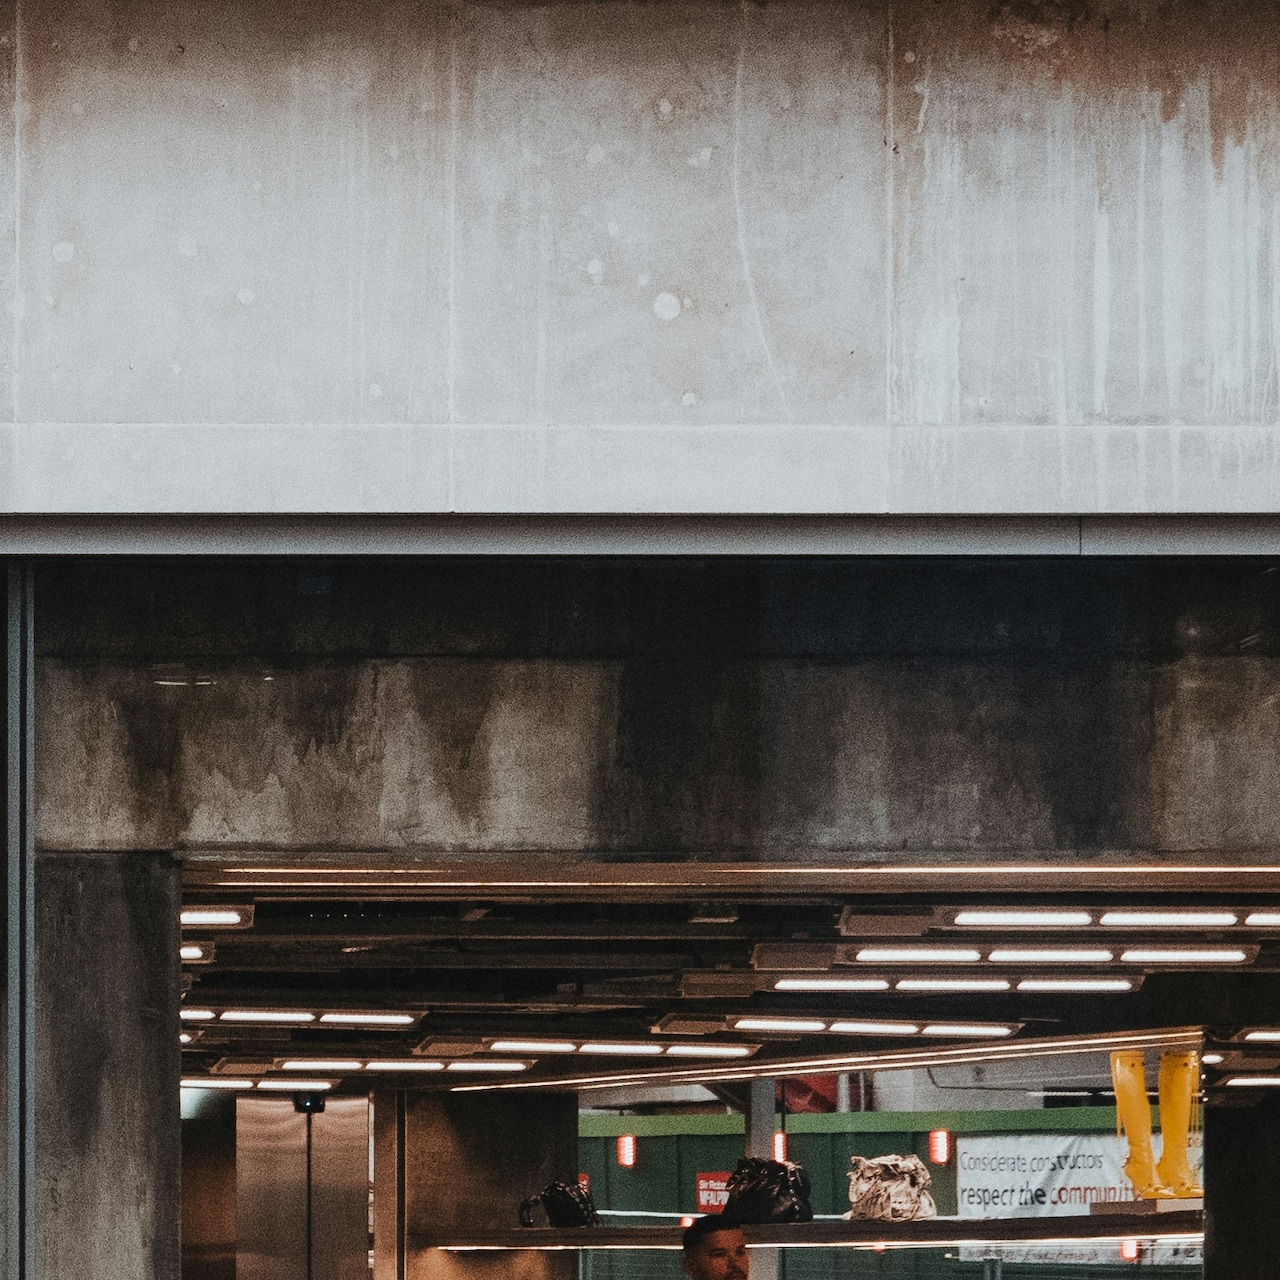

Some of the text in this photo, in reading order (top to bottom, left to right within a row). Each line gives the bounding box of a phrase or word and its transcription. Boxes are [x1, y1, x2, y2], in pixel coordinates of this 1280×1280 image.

[960, 1151, 1026, 1172] Considerate
[961, 1180, 1133, 1212] respect the communit
